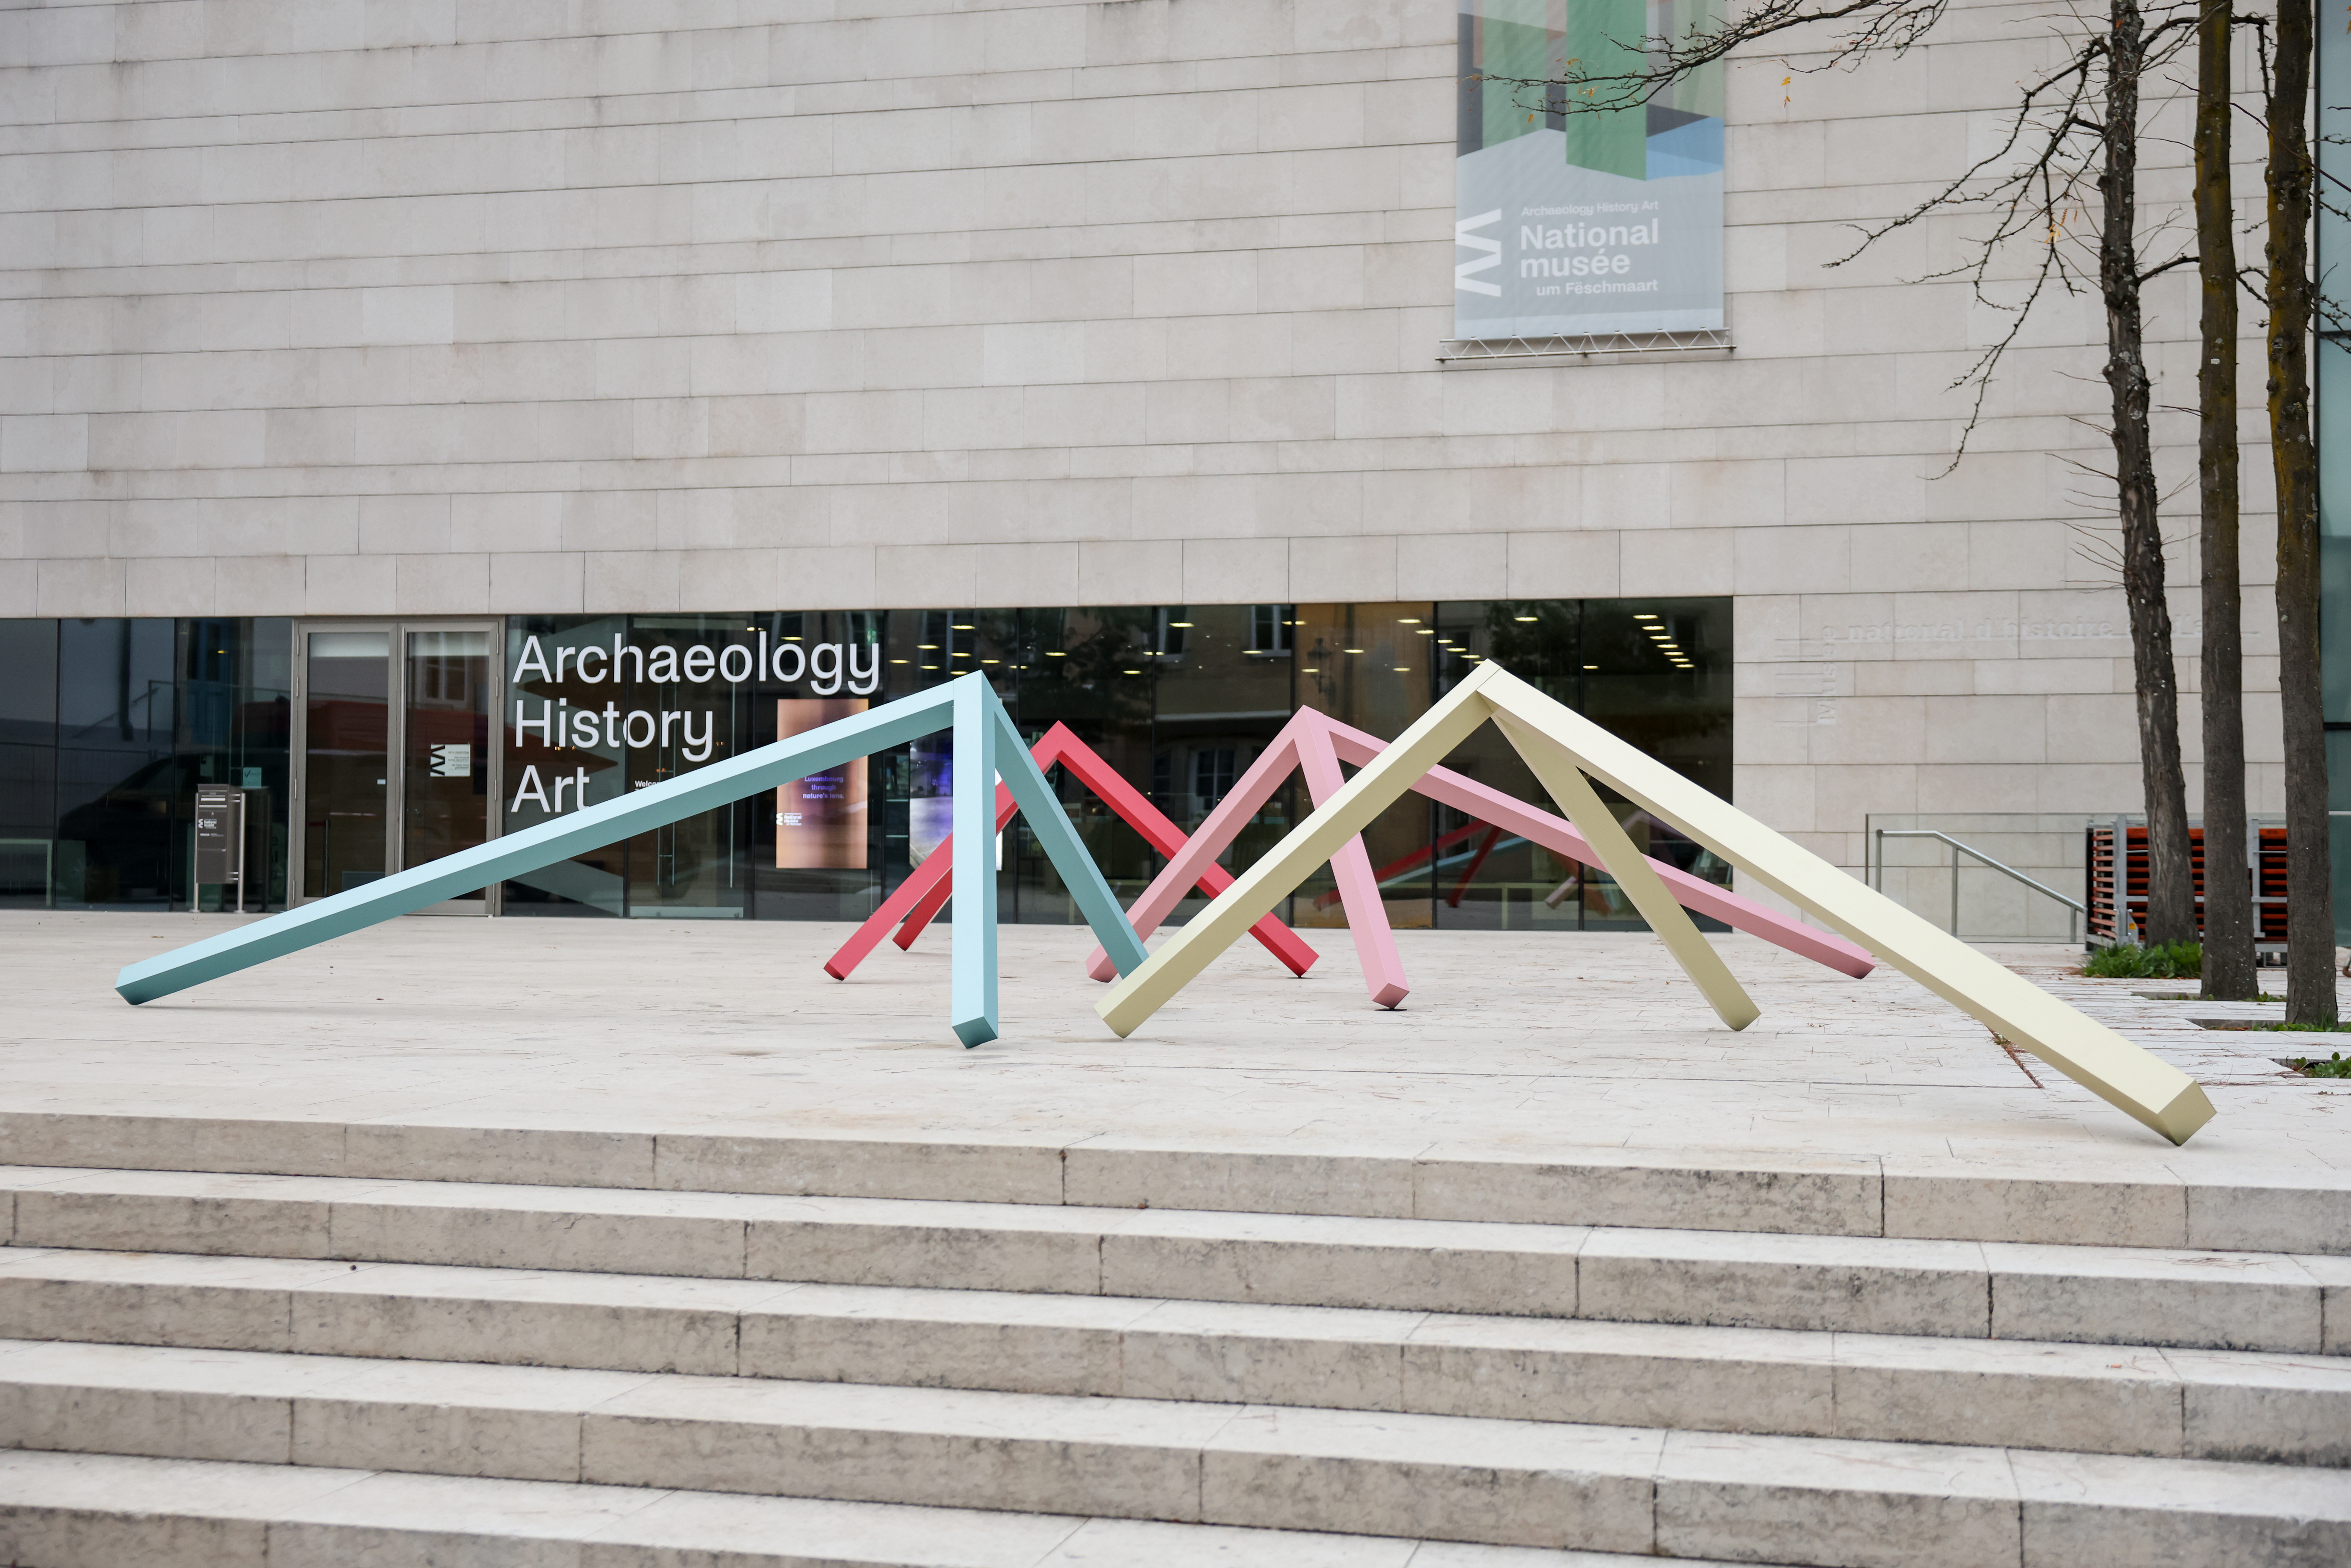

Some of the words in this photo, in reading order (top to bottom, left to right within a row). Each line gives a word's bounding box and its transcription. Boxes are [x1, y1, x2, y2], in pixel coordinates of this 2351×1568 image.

[1521, 203, 1594, 216] Archaeology
[1597, 202, 1638, 214] History
[1641, 200, 1659, 210] Art
[1520, 218, 1659, 251] National
[1520, 248, 1630, 278] musée
[1536, 285, 1560, 296] um
[1565, 279, 1658, 295] Fëschmaart
[513, 631, 880, 696] Archaeology
[516, 698, 713, 762] History
[511, 764, 590, 813] Art
